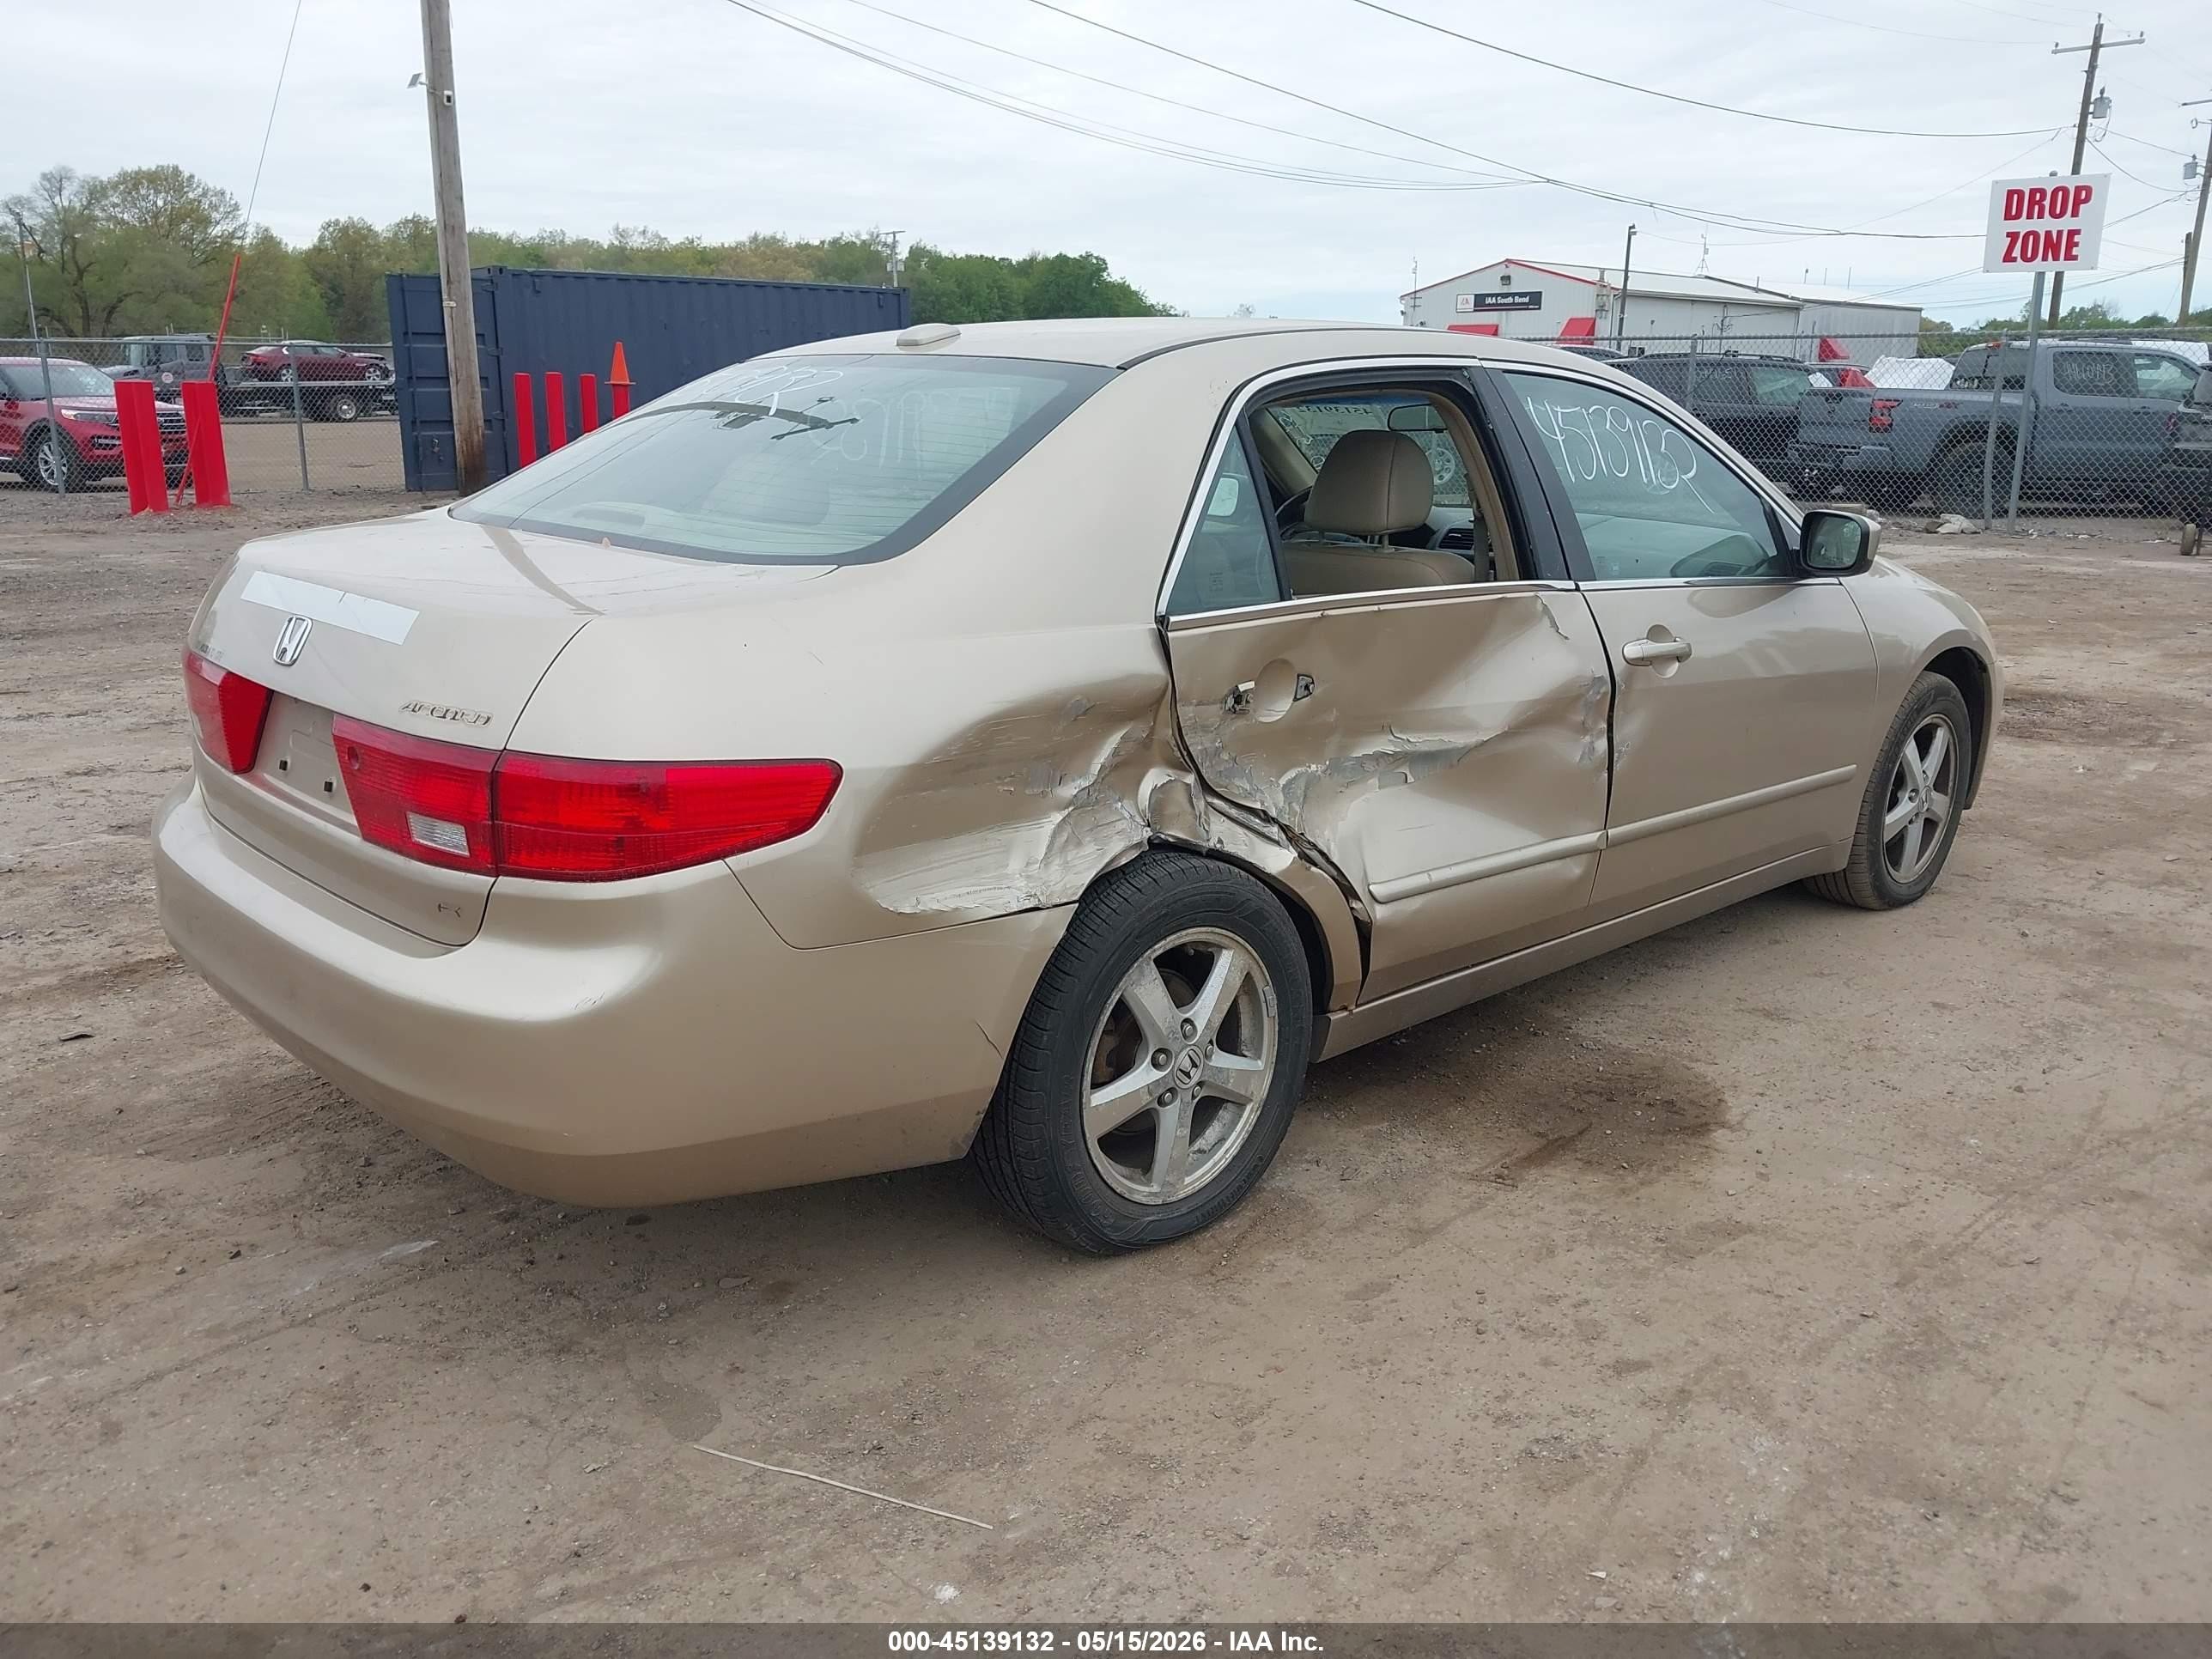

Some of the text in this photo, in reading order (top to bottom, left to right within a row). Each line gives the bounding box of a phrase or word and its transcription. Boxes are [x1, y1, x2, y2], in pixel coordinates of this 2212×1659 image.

[2003, 185, 2094, 221] DROP
[2002, 228, 2082, 263] ZONE
[1497, 295, 1514, 304] South
